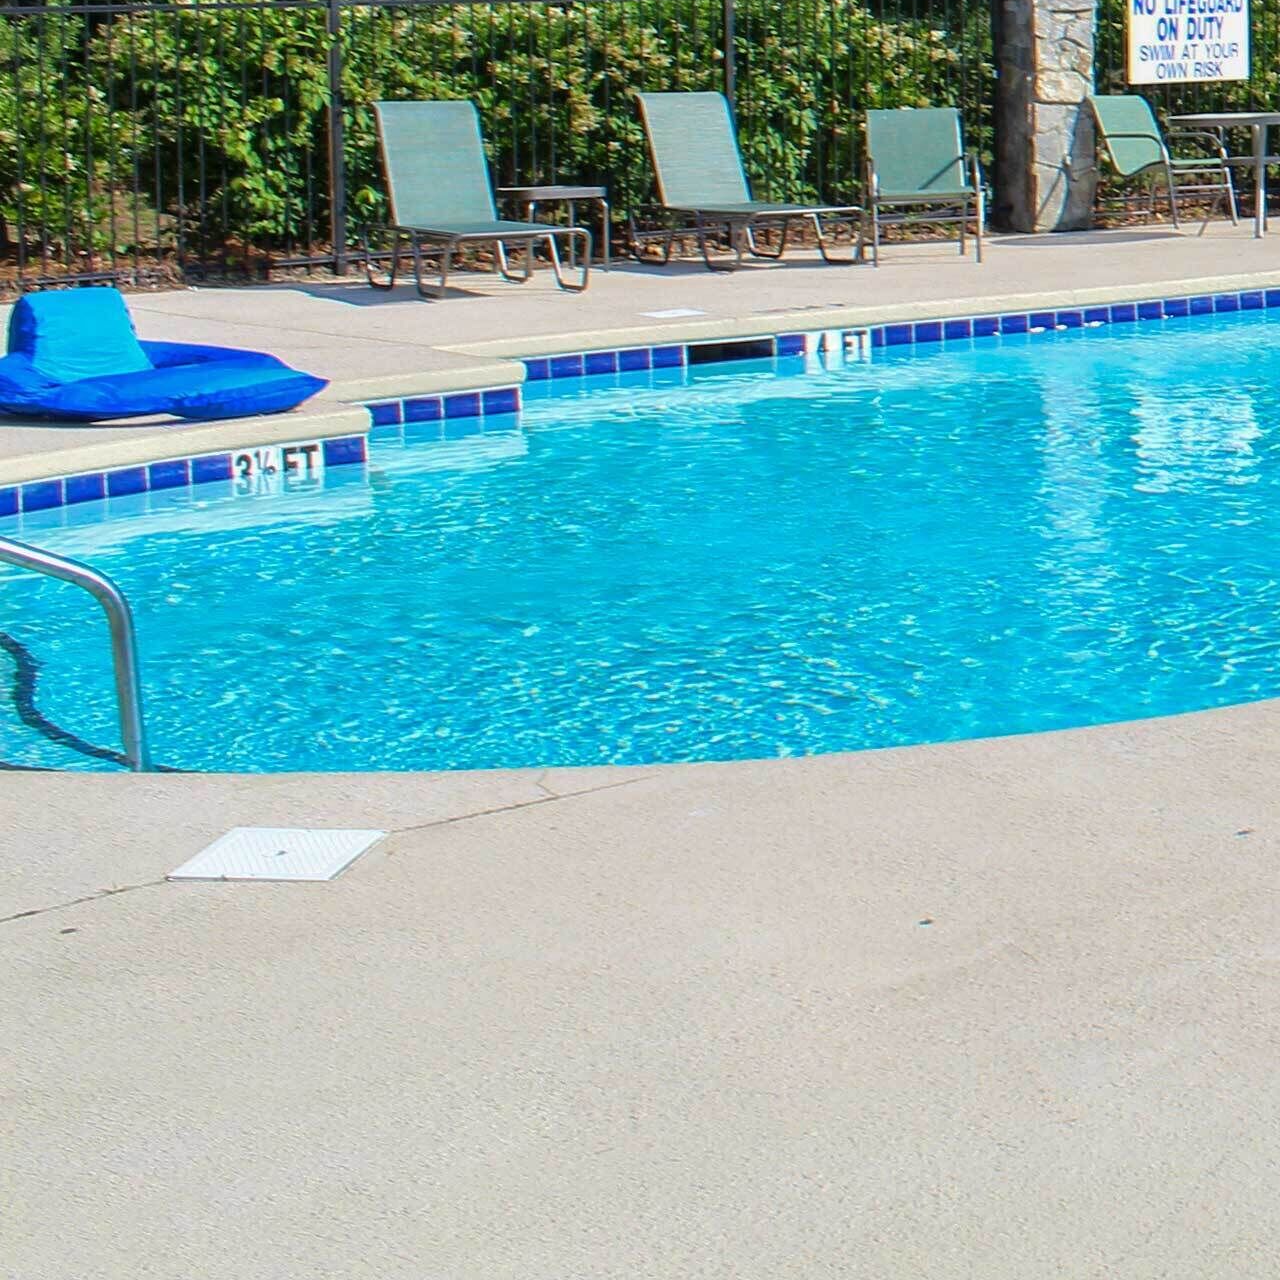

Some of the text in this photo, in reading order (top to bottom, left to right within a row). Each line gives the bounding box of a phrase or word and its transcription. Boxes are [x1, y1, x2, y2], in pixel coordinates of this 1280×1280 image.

[1157, 16, 1224, 41] ON DUTY
[1140, 43, 1239, 62] SWIM AT YOUR
[1156, 61, 1224, 80] OWN RISK
[842, 329, 867, 352] FT
[282, 443, 320, 472] FT
